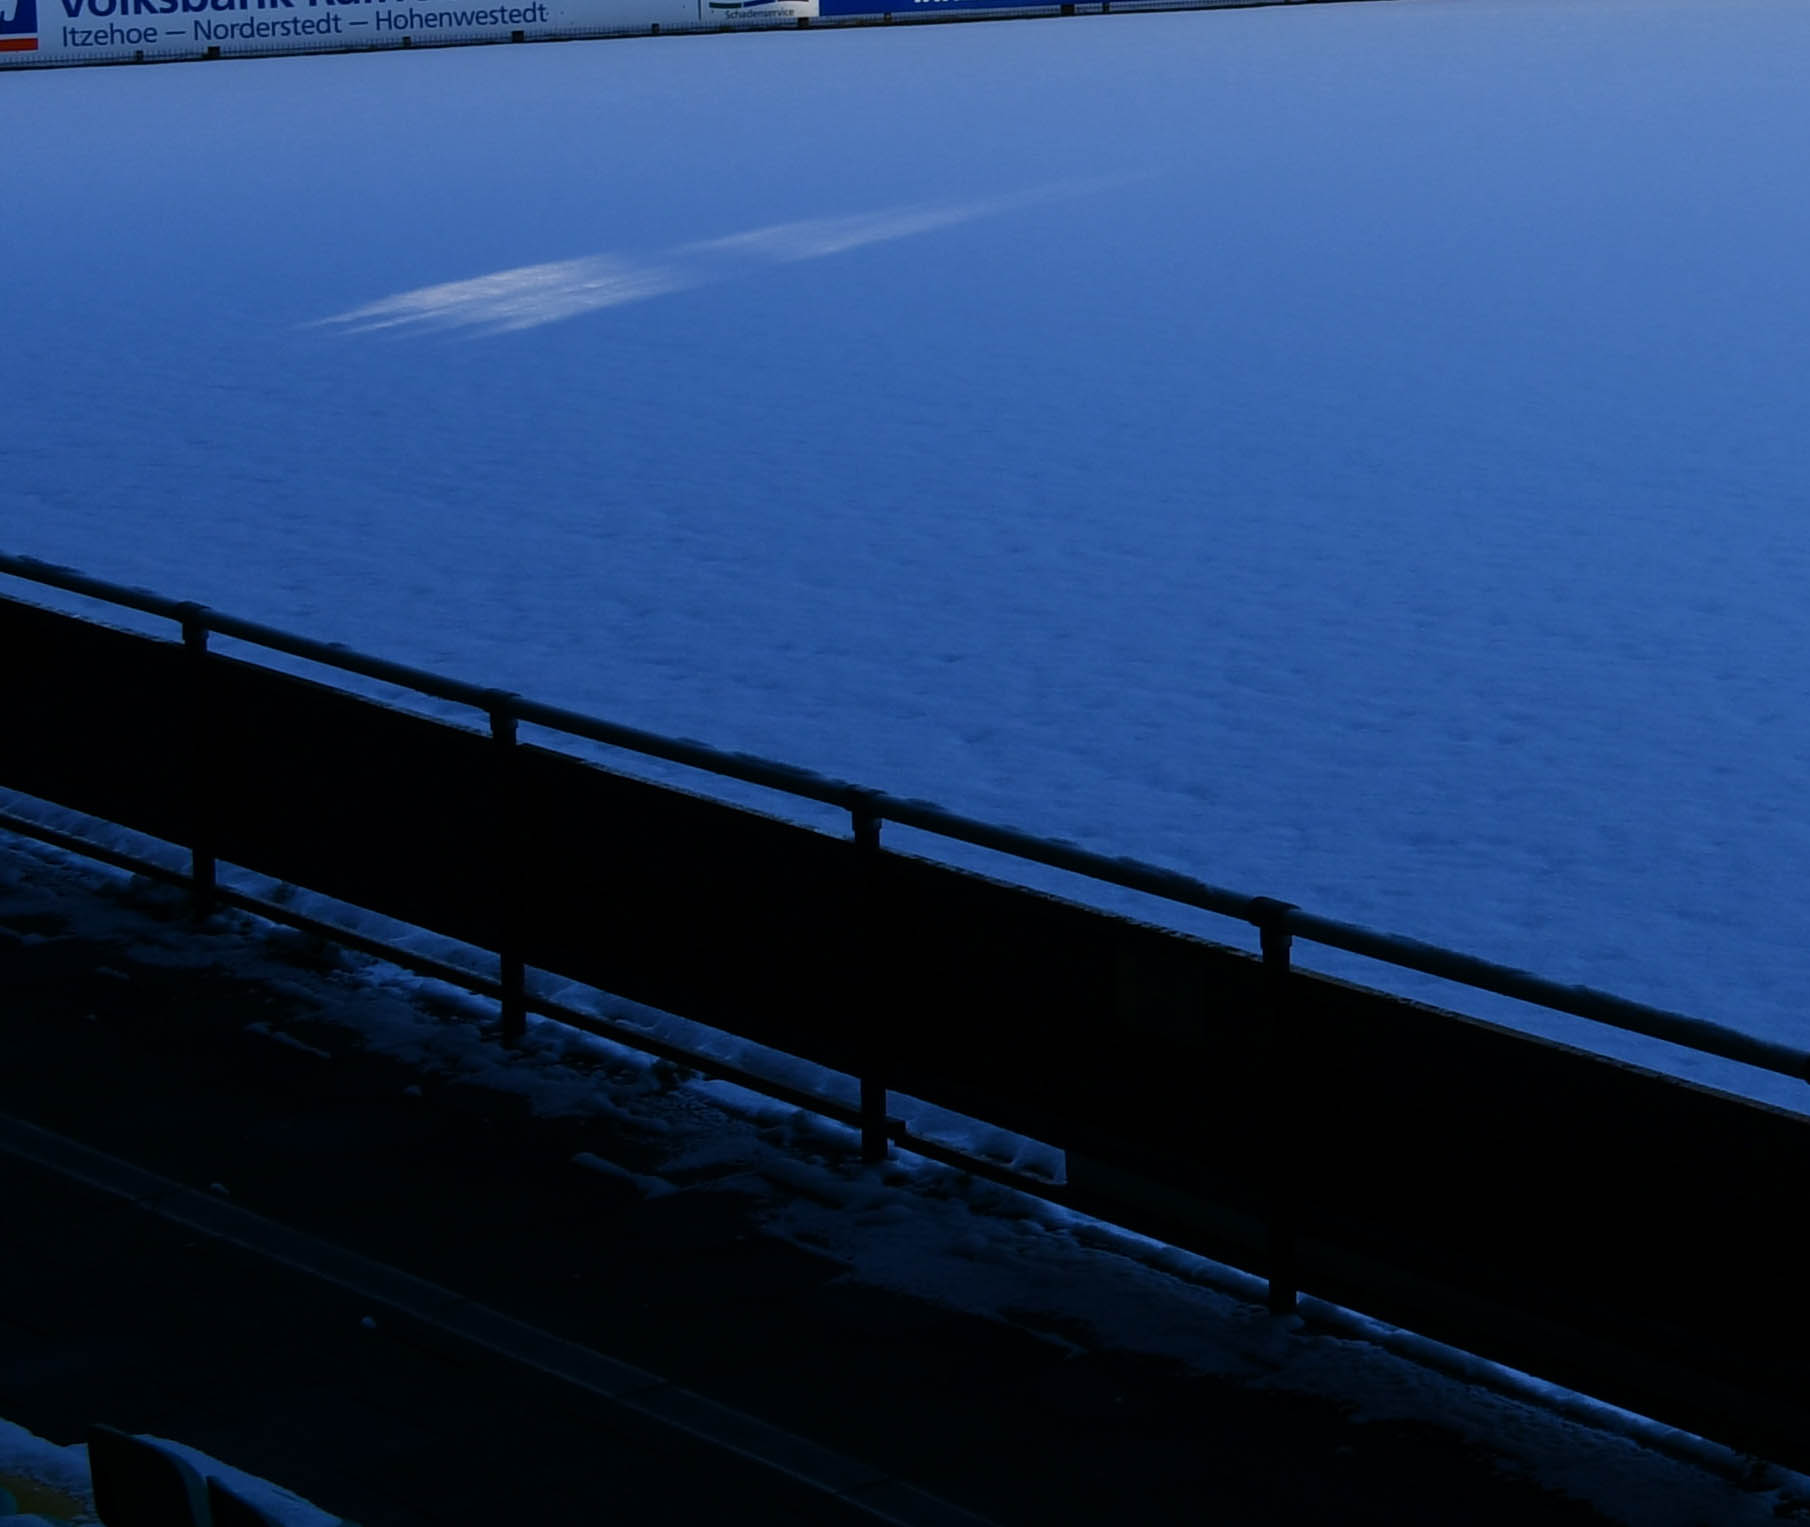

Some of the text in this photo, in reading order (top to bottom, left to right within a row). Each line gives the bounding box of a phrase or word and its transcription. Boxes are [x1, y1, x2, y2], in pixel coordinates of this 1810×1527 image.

[62, 2, 547, 48] Itzehoe Norderstedt Hohenwestedt
